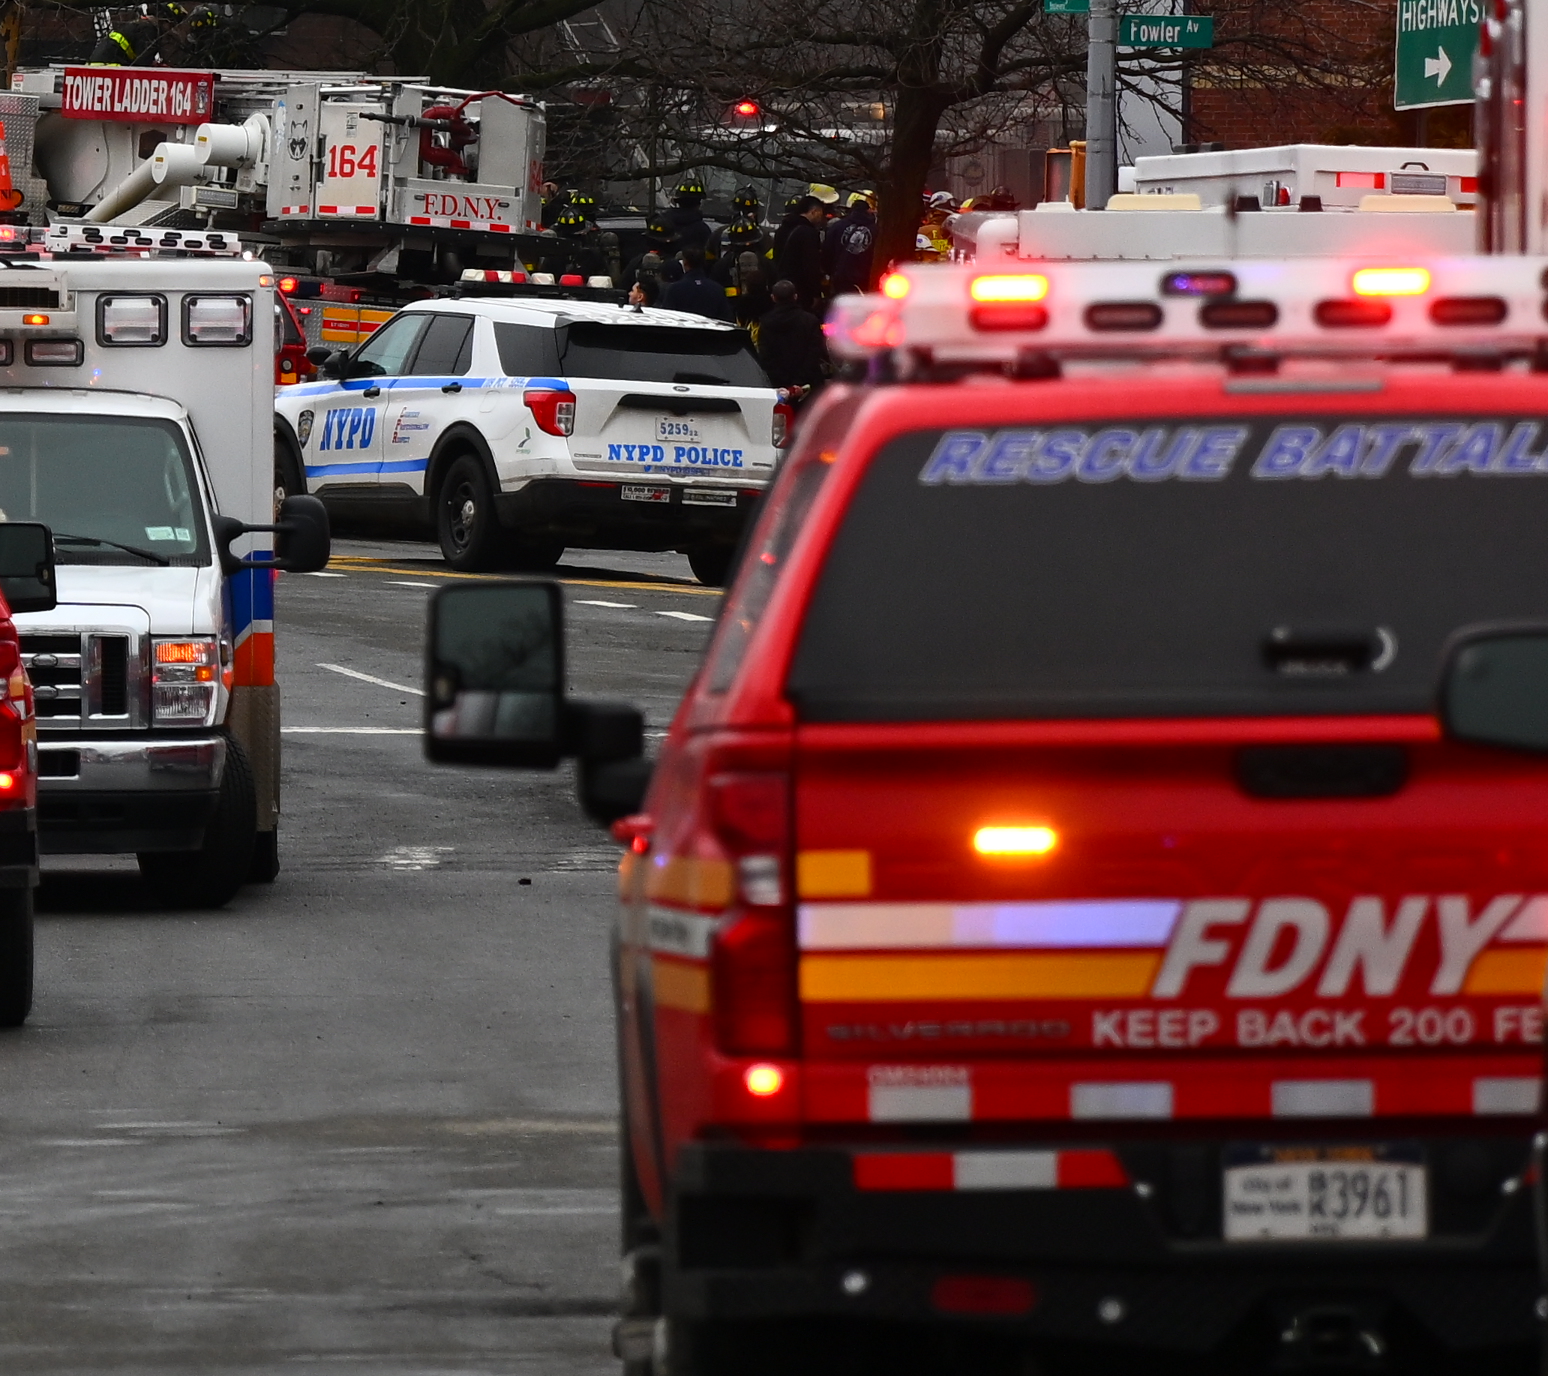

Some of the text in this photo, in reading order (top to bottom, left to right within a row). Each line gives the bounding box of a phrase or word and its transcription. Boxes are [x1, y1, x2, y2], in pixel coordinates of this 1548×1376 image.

[1130, 19, 1199, 44] Fowler Av
[64, 74, 112, 112] TOWER
[113, 77, 167, 116] LADDER
[169, 81, 193, 117] 164
[327, 144, 378, 179] 164
[422, 192, 503, 221] F.D.N.Y.
[319, 407, 377, 451] NYPD
[659, 421, 690, 436] 5259
[607, 443, 744, 468] NYPD POLICE
[918, 428, 1247, 487] RESCUE
[1150, 893, 1525, 1000] FDNY
[1091, 1007, 1221, 1047] KEEP
[1236, 1007, 1367, 1046] BACK
[1389, 1006, 1474, 1045] 200
[1330, 1168, 1410, 1221] 3961
